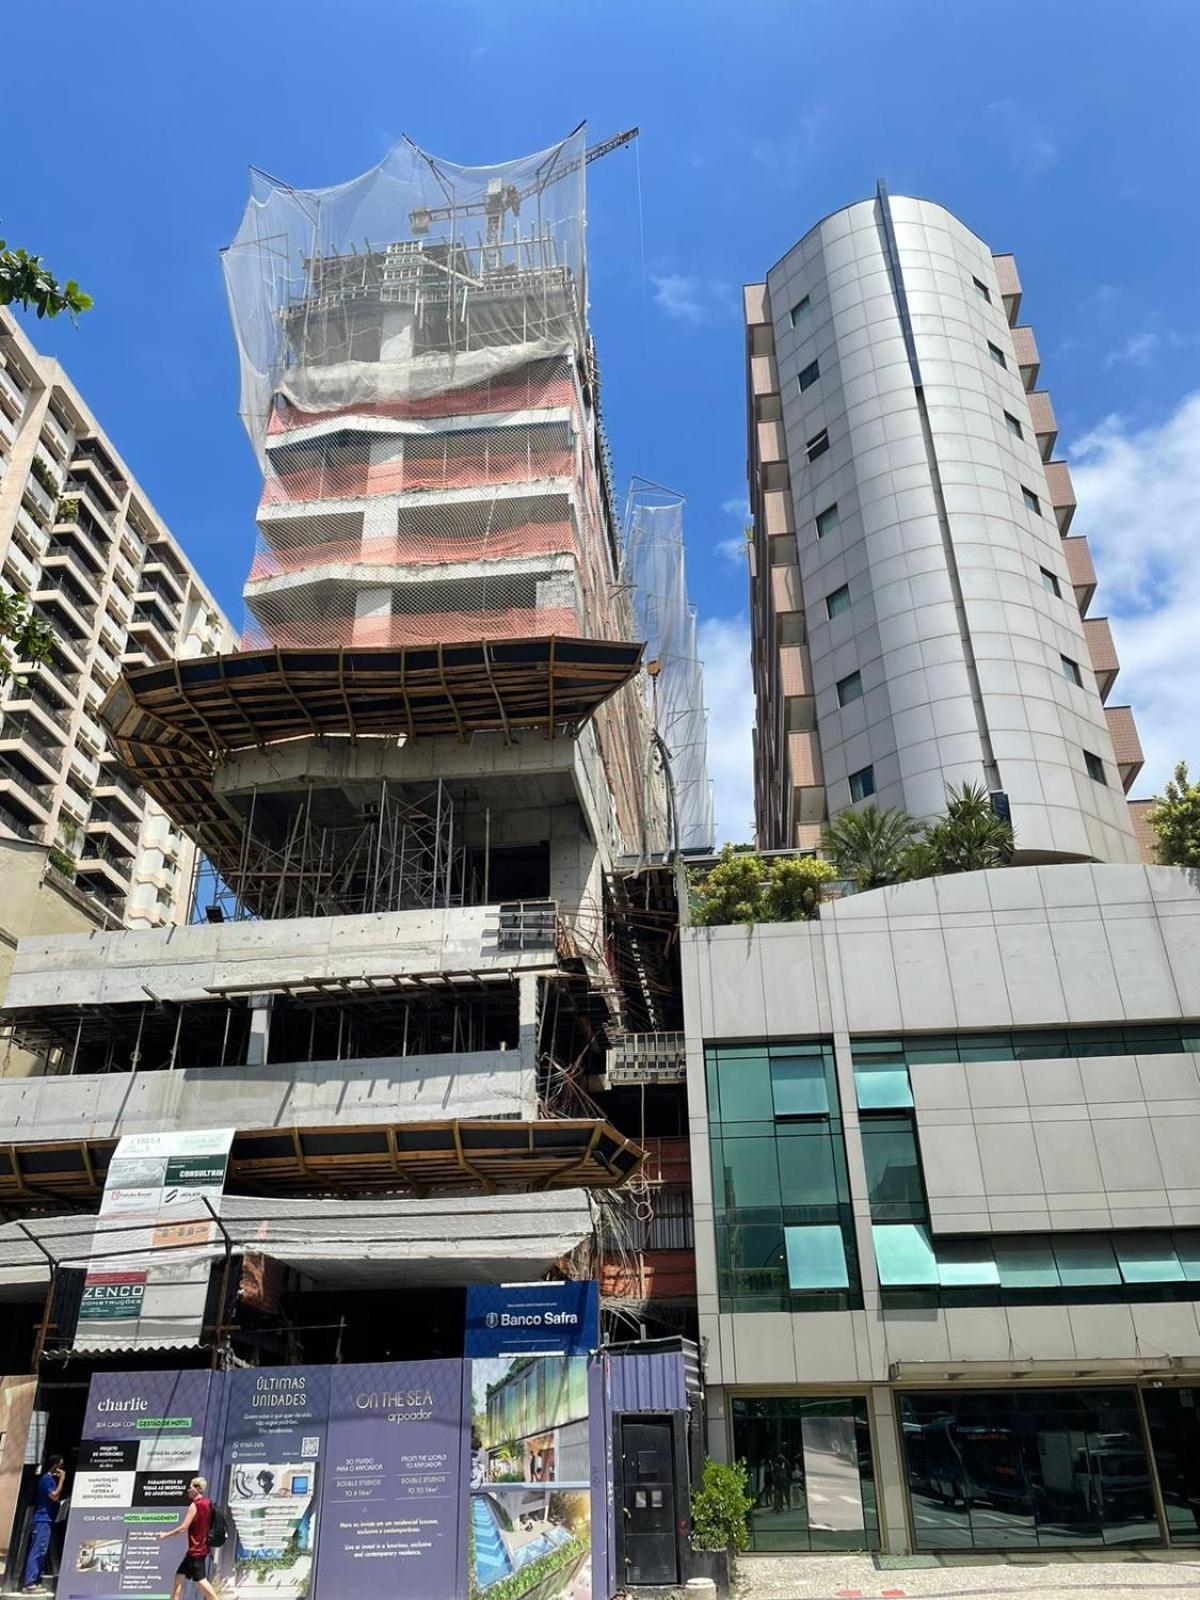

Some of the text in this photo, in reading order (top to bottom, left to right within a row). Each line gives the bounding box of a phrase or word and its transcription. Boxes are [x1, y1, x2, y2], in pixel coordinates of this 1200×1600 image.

[83, 1285, 144, 1298] ZENCO
[501, 1312, 578, 1326] Banco Safra
[256, 1376, 305, 1390] ÚLTIMAS
[97, 1397, 148, 1411] charlie
[252, 1393, 306, 1407] UNIDADES
[356, 1390, 433, 1408] ON THE SEA
[388, 1409, 432, 1424] arpoador
